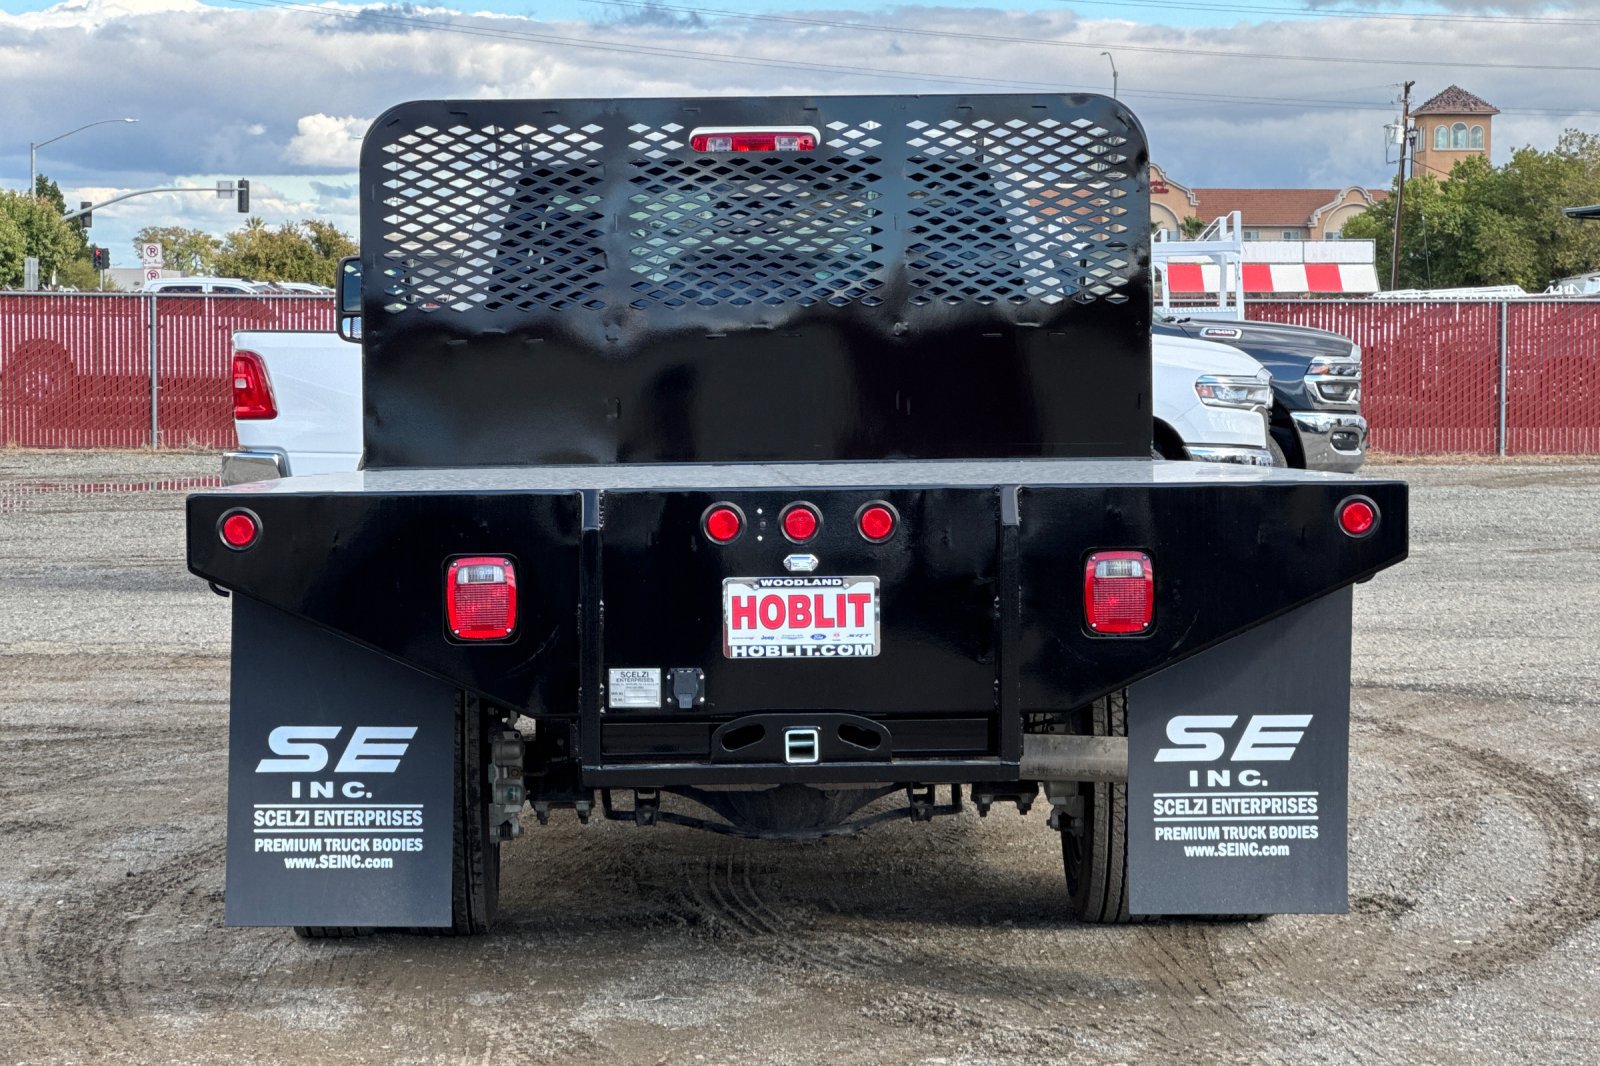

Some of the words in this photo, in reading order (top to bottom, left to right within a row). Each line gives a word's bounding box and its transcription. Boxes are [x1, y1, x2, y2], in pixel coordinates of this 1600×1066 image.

[760, 578, 843, 587] WOODLAND
[731, 593, 871, 630] HOBLIT
[732, 644, 873, 657] HOBLIT.COM
[1153, 714, 1314, 762] SE
[255, 725, 418, 773] SE
[1189, 769, 1268, 787] INC.
[291, 781, 373, 798] INC.
[1153, 798, 1208, 815] SCELZI
[1211, 797, 1318, 815] ENTERPRISES
[253, 810, 310, 827] SCELZI
[314, 810, 423, 826] ENTERPRISES
[1155, 826, 1220, 841] PREMIUM
[1222, 825, 1267, 840] TRUCK
[1269, 825, 1319, 839] BODIES
[254, 838, 322, 852] PREMIUM
[323, 838, 370, 852] TRUCK
[372, 837, 424, 851] BODIES
[1183, 841, 1290, 857] www.SEINC.com
[284, 854, 394, 869] www.SEINC.com
